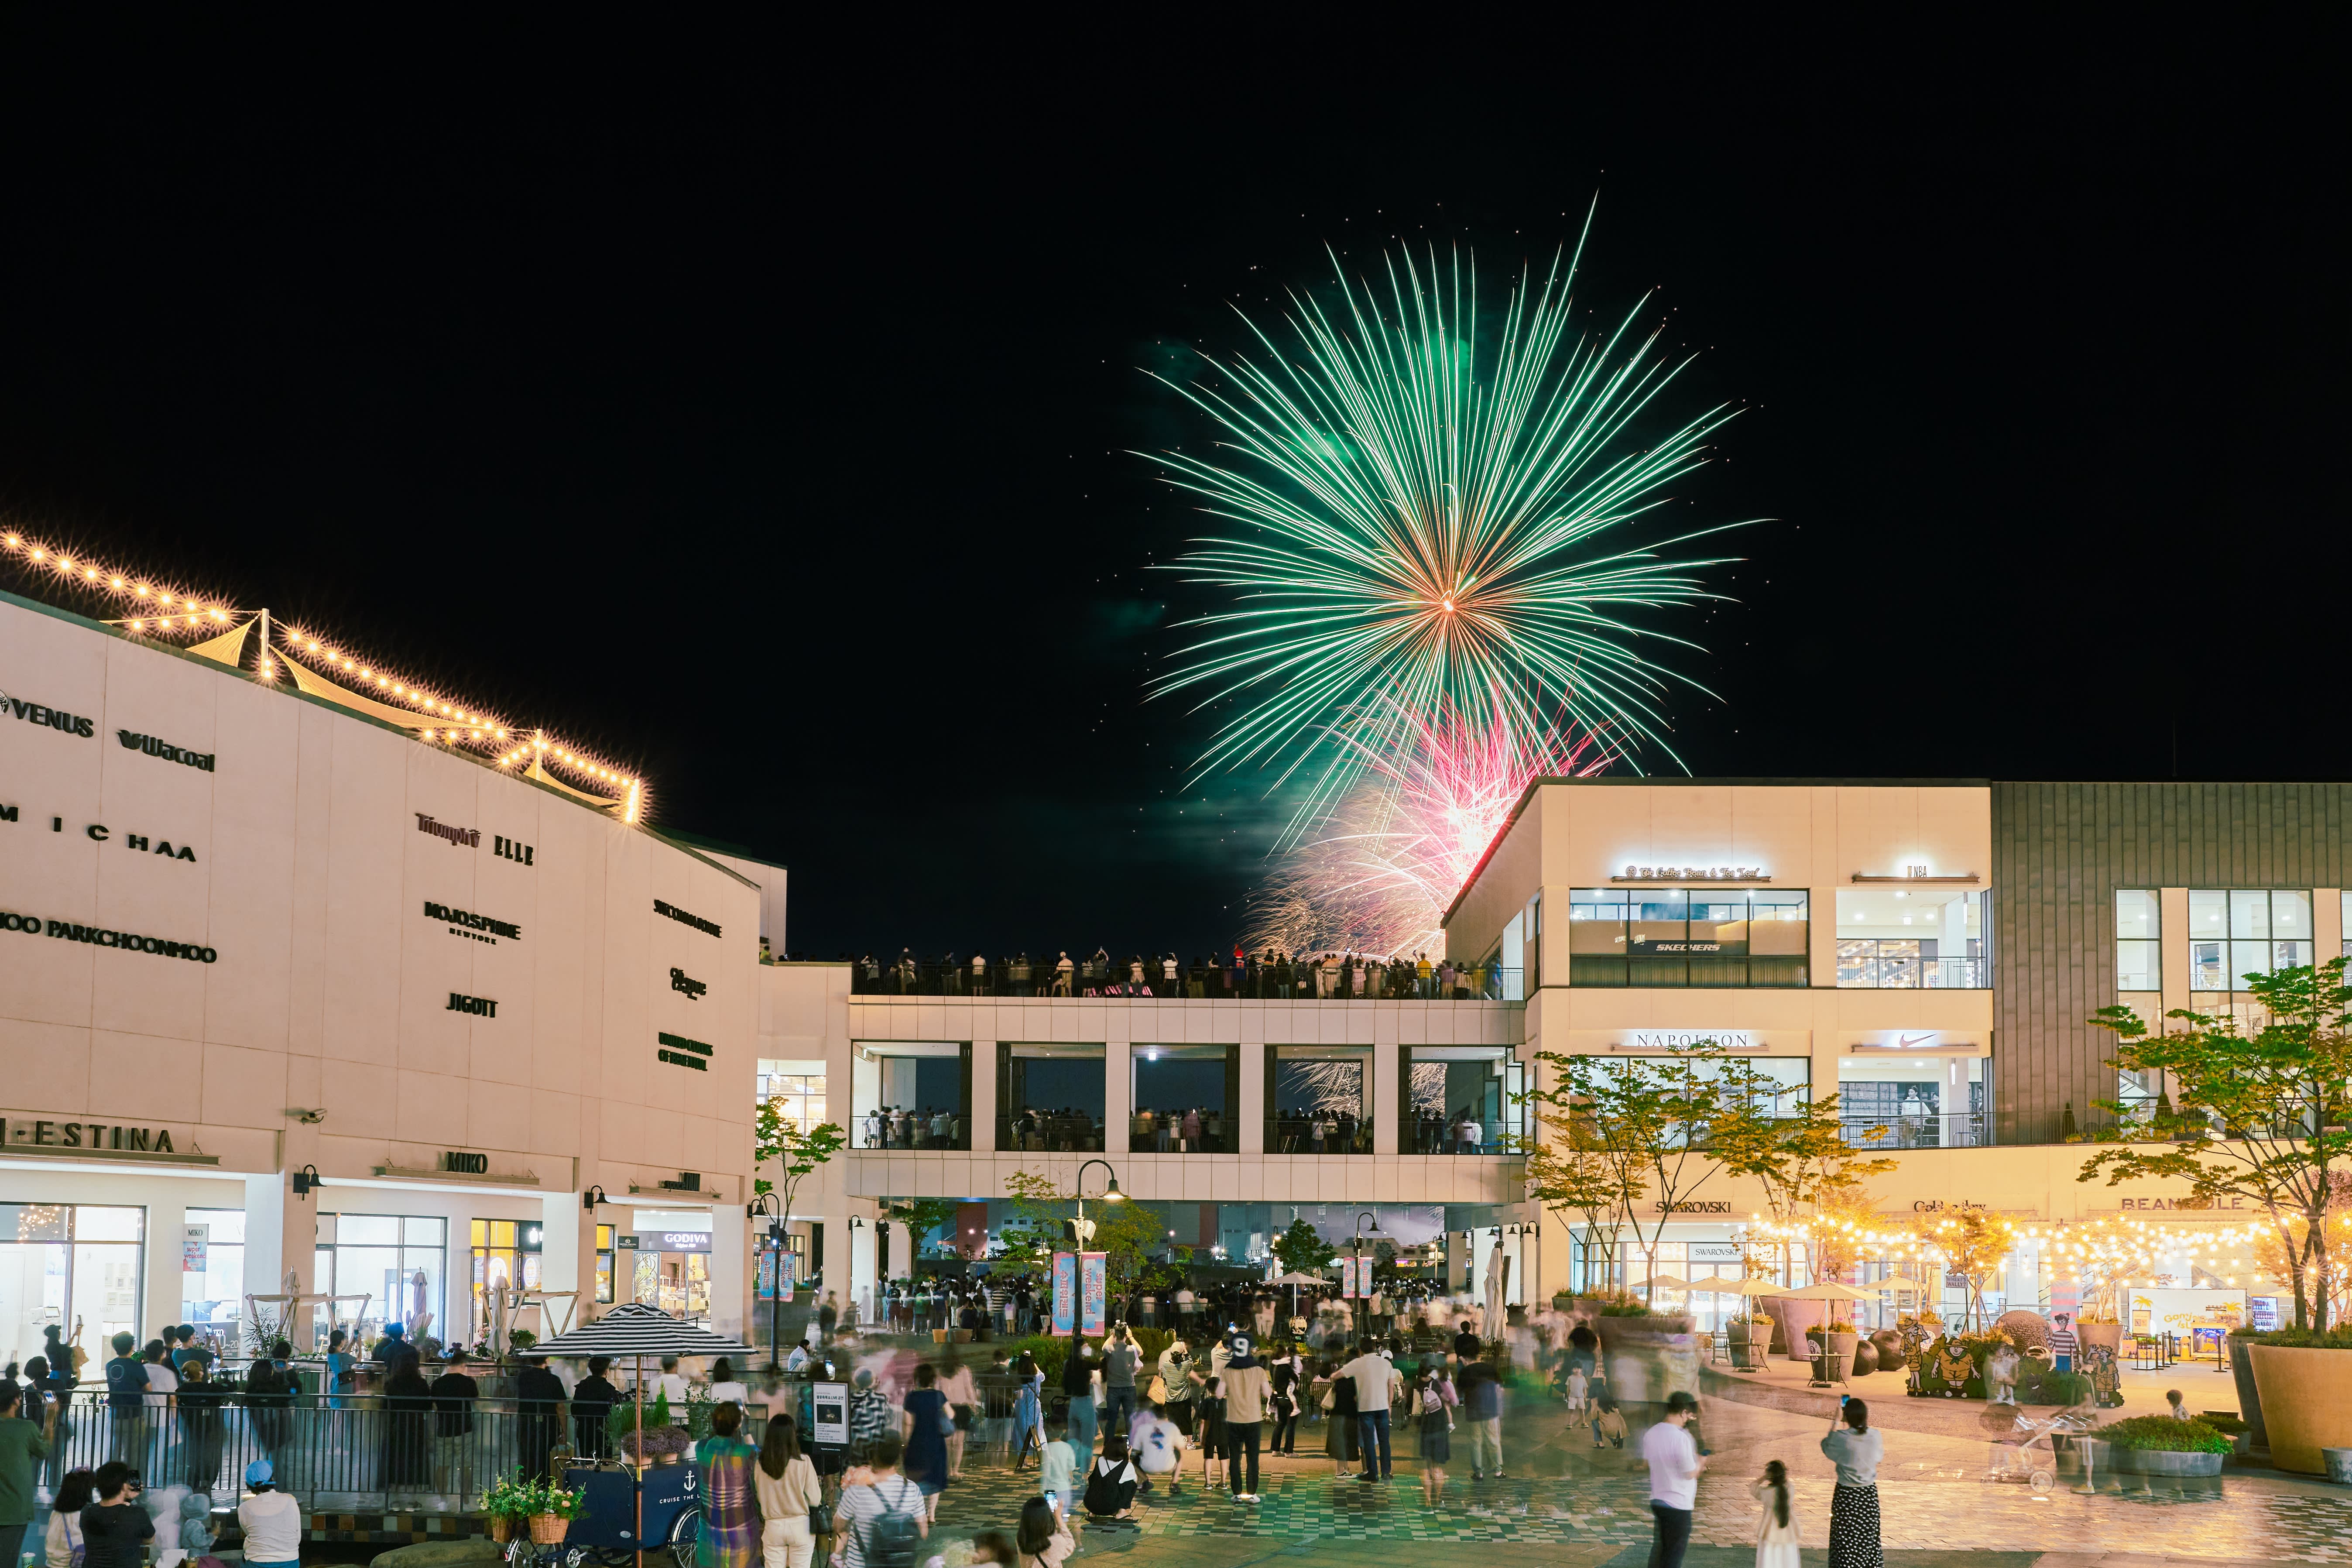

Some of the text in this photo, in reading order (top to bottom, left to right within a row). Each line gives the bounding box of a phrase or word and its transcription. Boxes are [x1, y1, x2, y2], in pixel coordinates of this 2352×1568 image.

[11, 698, 93, 738] VENUS
[142, 734, 215, 772] Wacoal
[0, 804, 196, 862] MICHAA
[415, 813, 471, 846] Triumph
[494, 835, 533, 866] ELLE
[1639, 867, 1760, 878] The Coffee Bean & Tea Leaf
[1914, 866, 1927, 878] NBA
[48, 920, 217, 964] PARKCHOONMOO
[446, 993, 498, 1018] JIGOTT
[447, 1152, 488, 1174] MIKO
[665, 1234, 707, 1243] GODIVA
[1059, 1270, 1068, 1318] 슈퍼위켄드
[1085, 1269, 1095, 1314] weekend
[1093, 1273, 1102, 1302] super
[1234, 1338, 1249, 1357] 9
